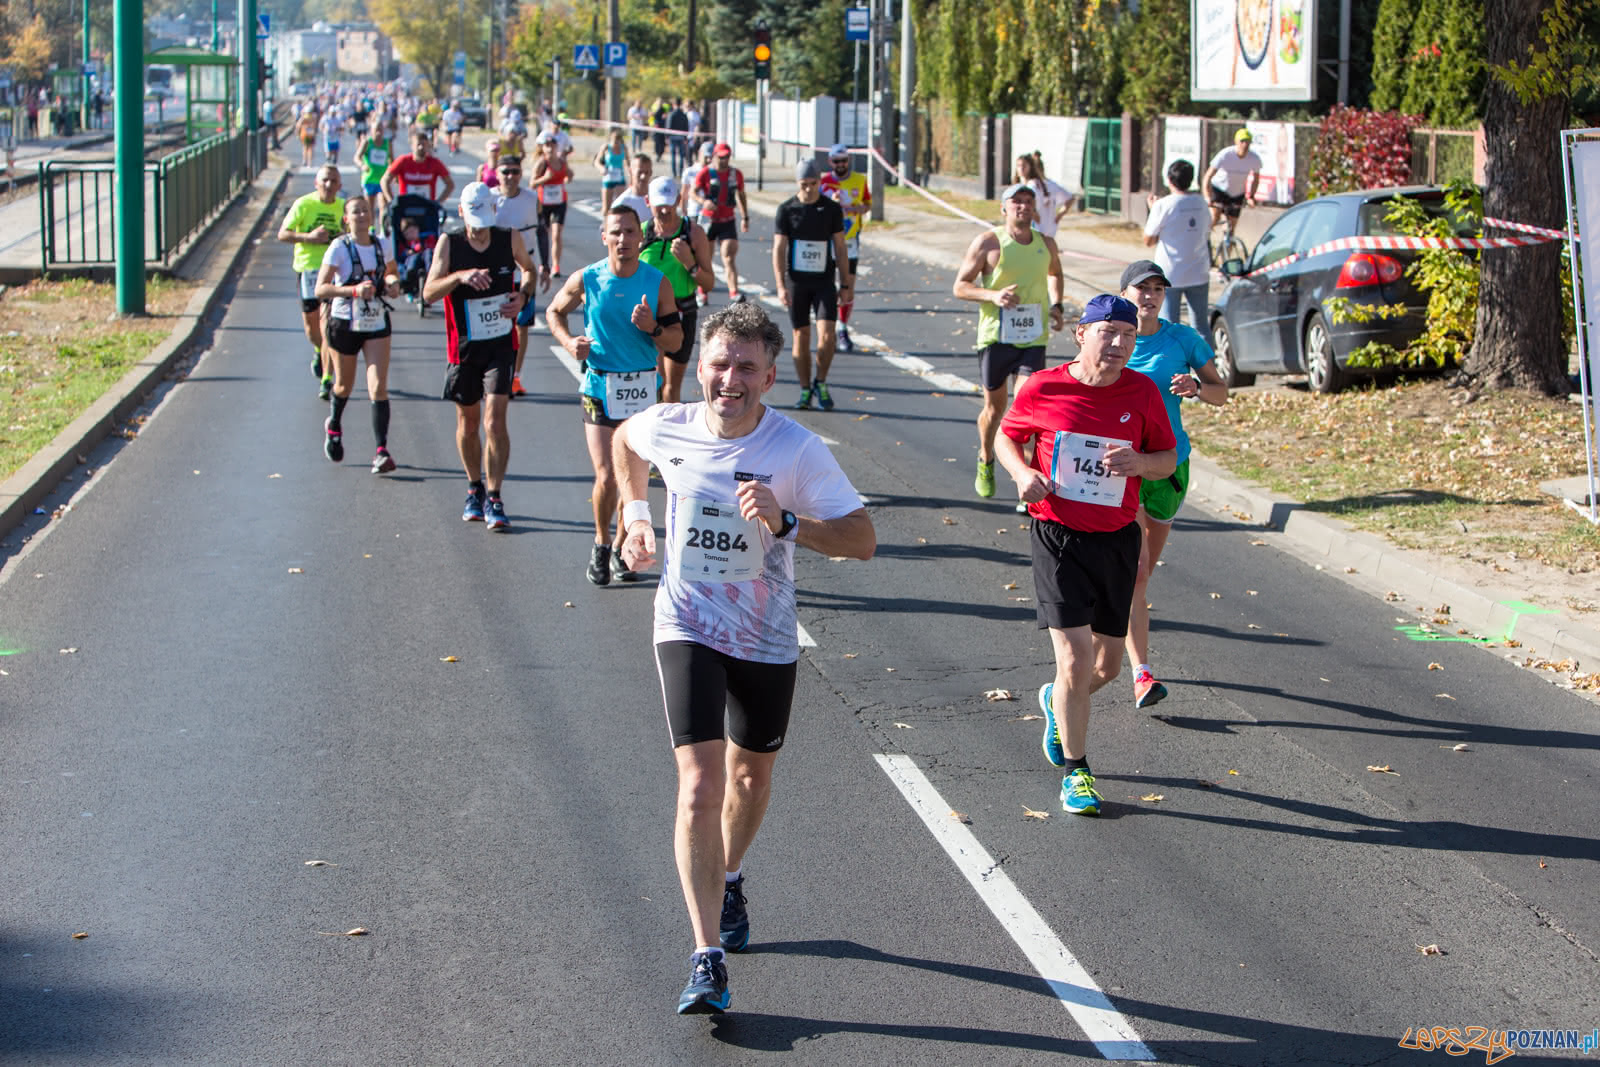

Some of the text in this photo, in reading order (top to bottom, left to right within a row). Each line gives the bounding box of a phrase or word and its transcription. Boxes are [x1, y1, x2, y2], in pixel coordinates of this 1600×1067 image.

[609, 45, 623, 64] P
[1010, 317, 1034, 328] 1488
[616, 387, 648, 400] 5706
[686, 527, 748, 552] 2884
[704, 553, 729, 562] Tomasz
